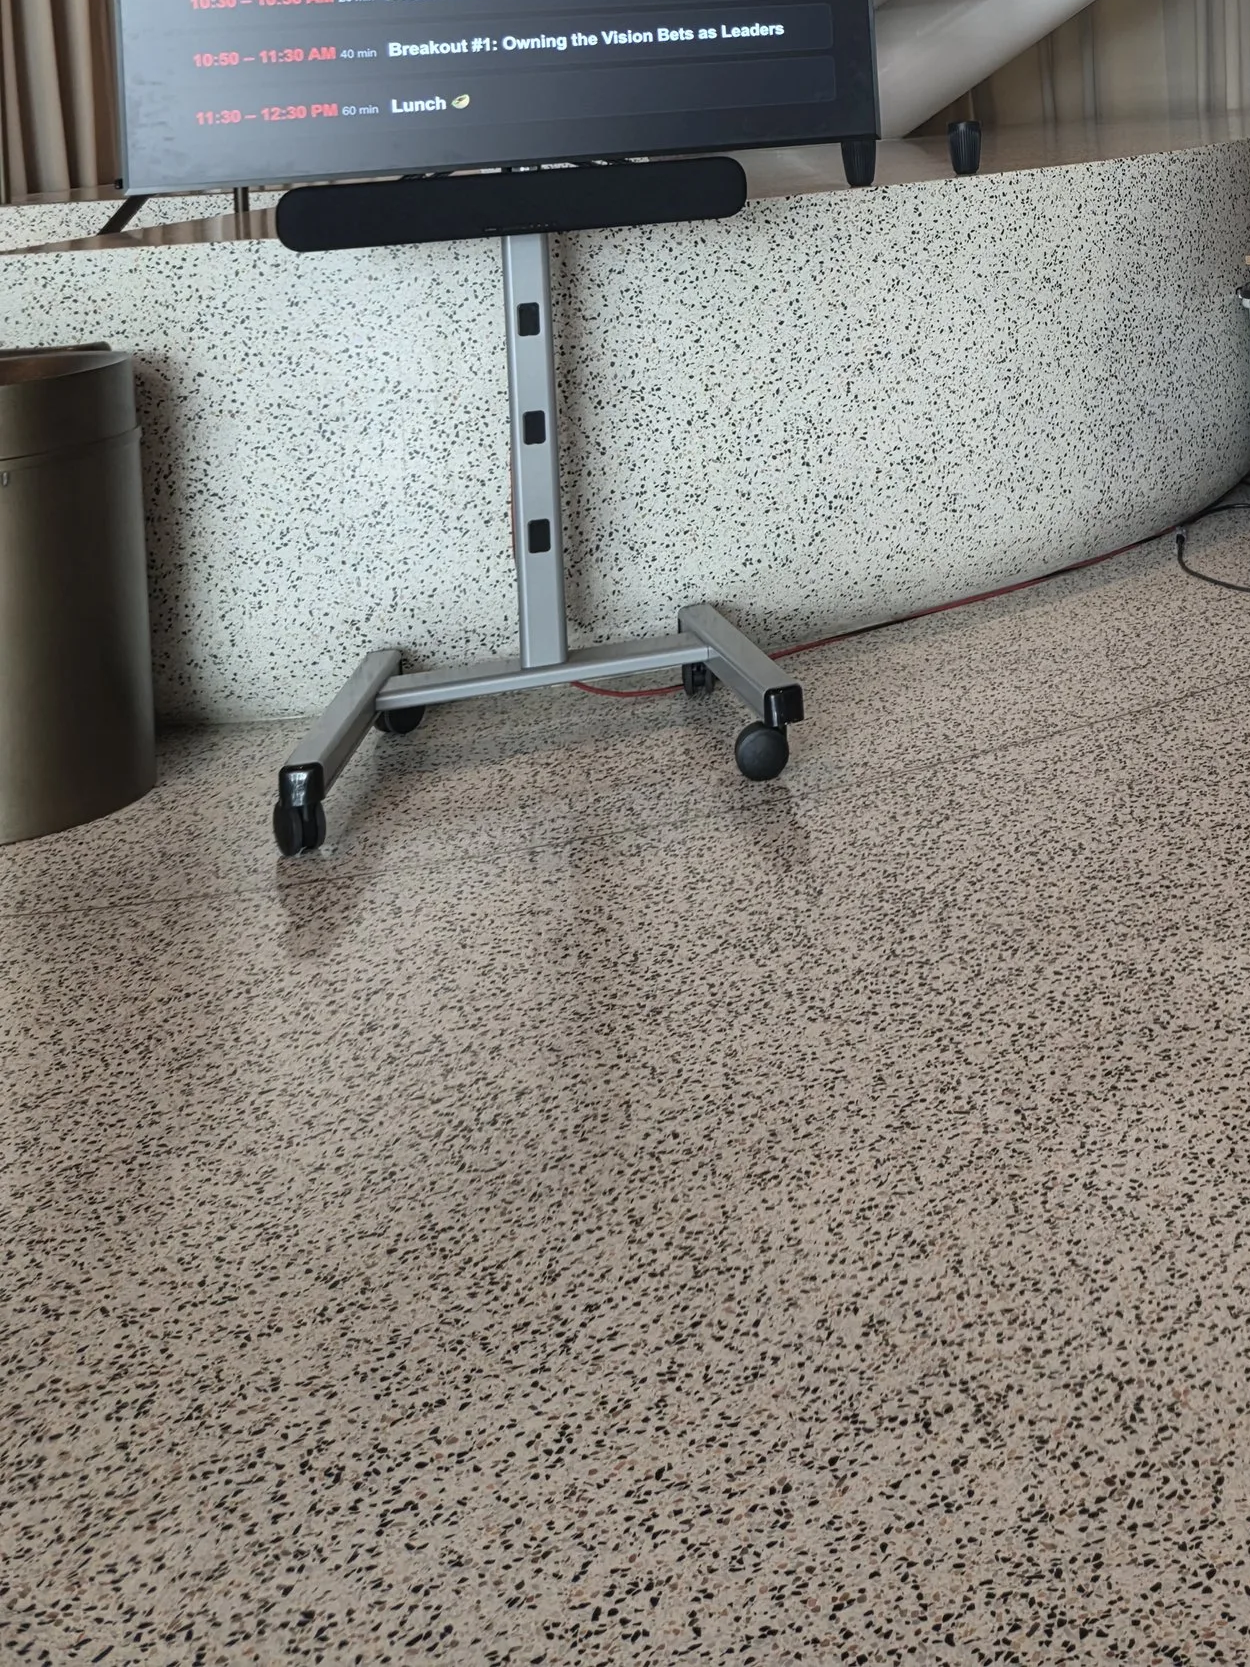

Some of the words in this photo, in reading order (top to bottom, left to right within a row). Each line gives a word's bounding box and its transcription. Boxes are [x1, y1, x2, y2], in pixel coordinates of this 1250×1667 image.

[388, 39, 468, 57] Breakout
[471, 37, 498, 53] #1:
[502, 34, 567, 51] Owning
[571, 32, 598, 46] the
[601, 29, 653, 45] Vision
[657, 27, 694, 42] Bets
[698, 27, 717, 39] as
[721, 23, 785, 39] Leaders
[193, 51, 240, 67] 10:50
[259, 48, 304, 64] 11:30
[308, 47, 337, 60] AM
[339, 49, 354, 59] 40
[357, 48, 377, 58] min
[196, 109, 242, 125] 11:30
[261, 105, 307, 122] 12:30
[311, 103, 339, 118] PM
[342, 105, 357, 116] 60
[359, 103, 379, 115] min
[391, 96, 447, 114] Lunch
